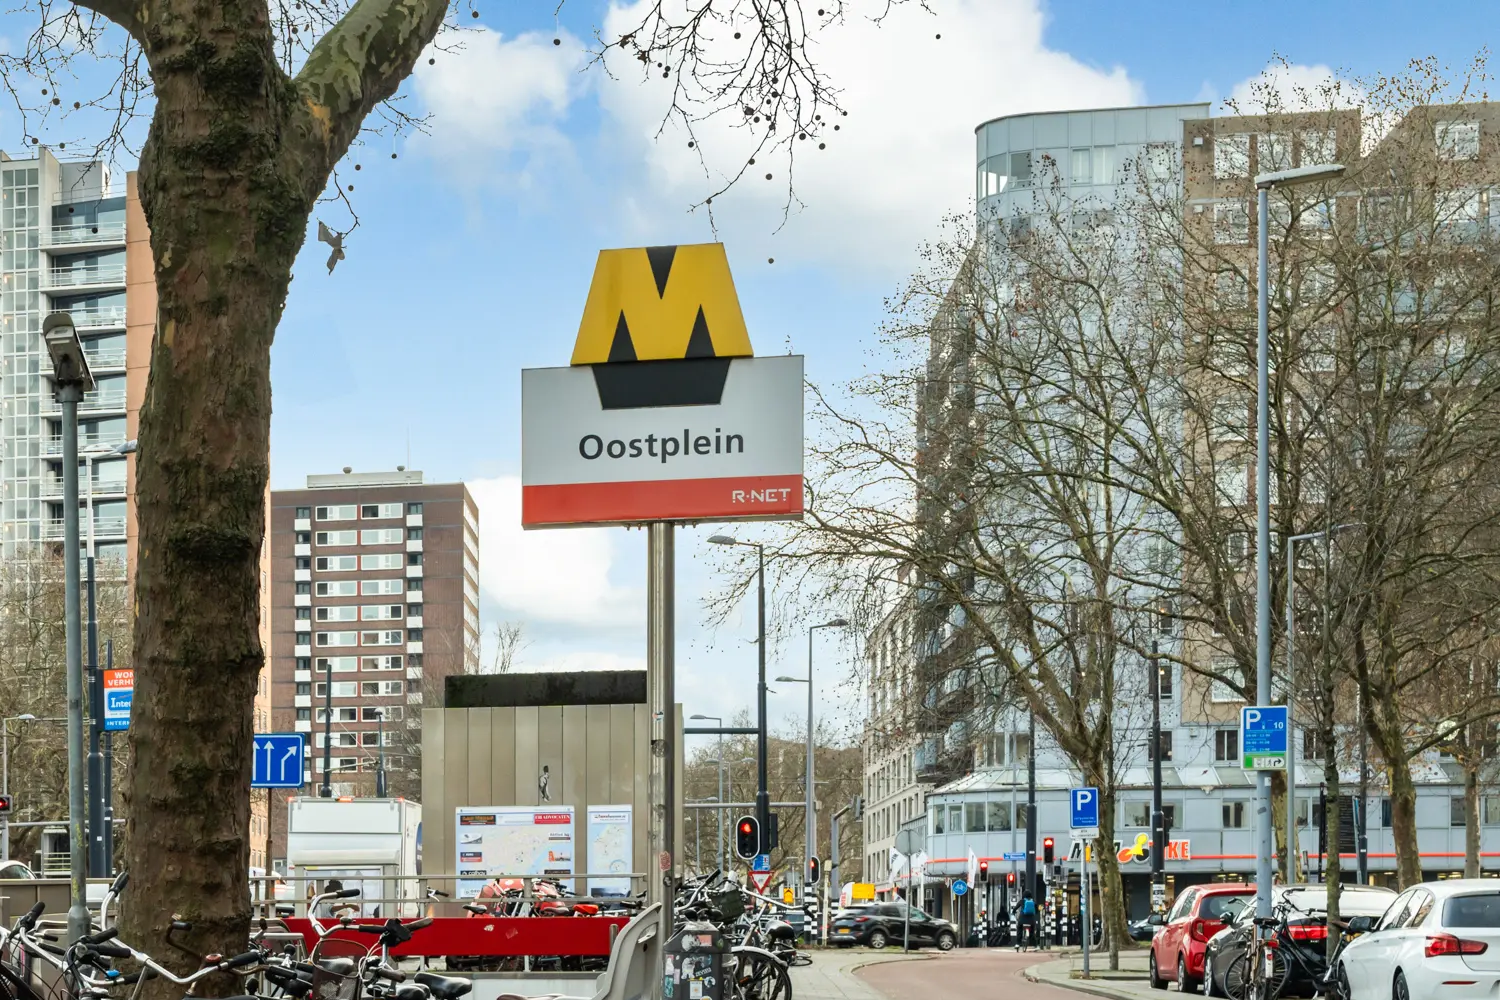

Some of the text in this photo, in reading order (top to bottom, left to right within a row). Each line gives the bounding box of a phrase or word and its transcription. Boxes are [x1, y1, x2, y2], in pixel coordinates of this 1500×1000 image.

[579, 428, 744, 463] Oostplein
[1246, 710, 1284, 730] P 10
[1076, 790, 1092, 811] P
